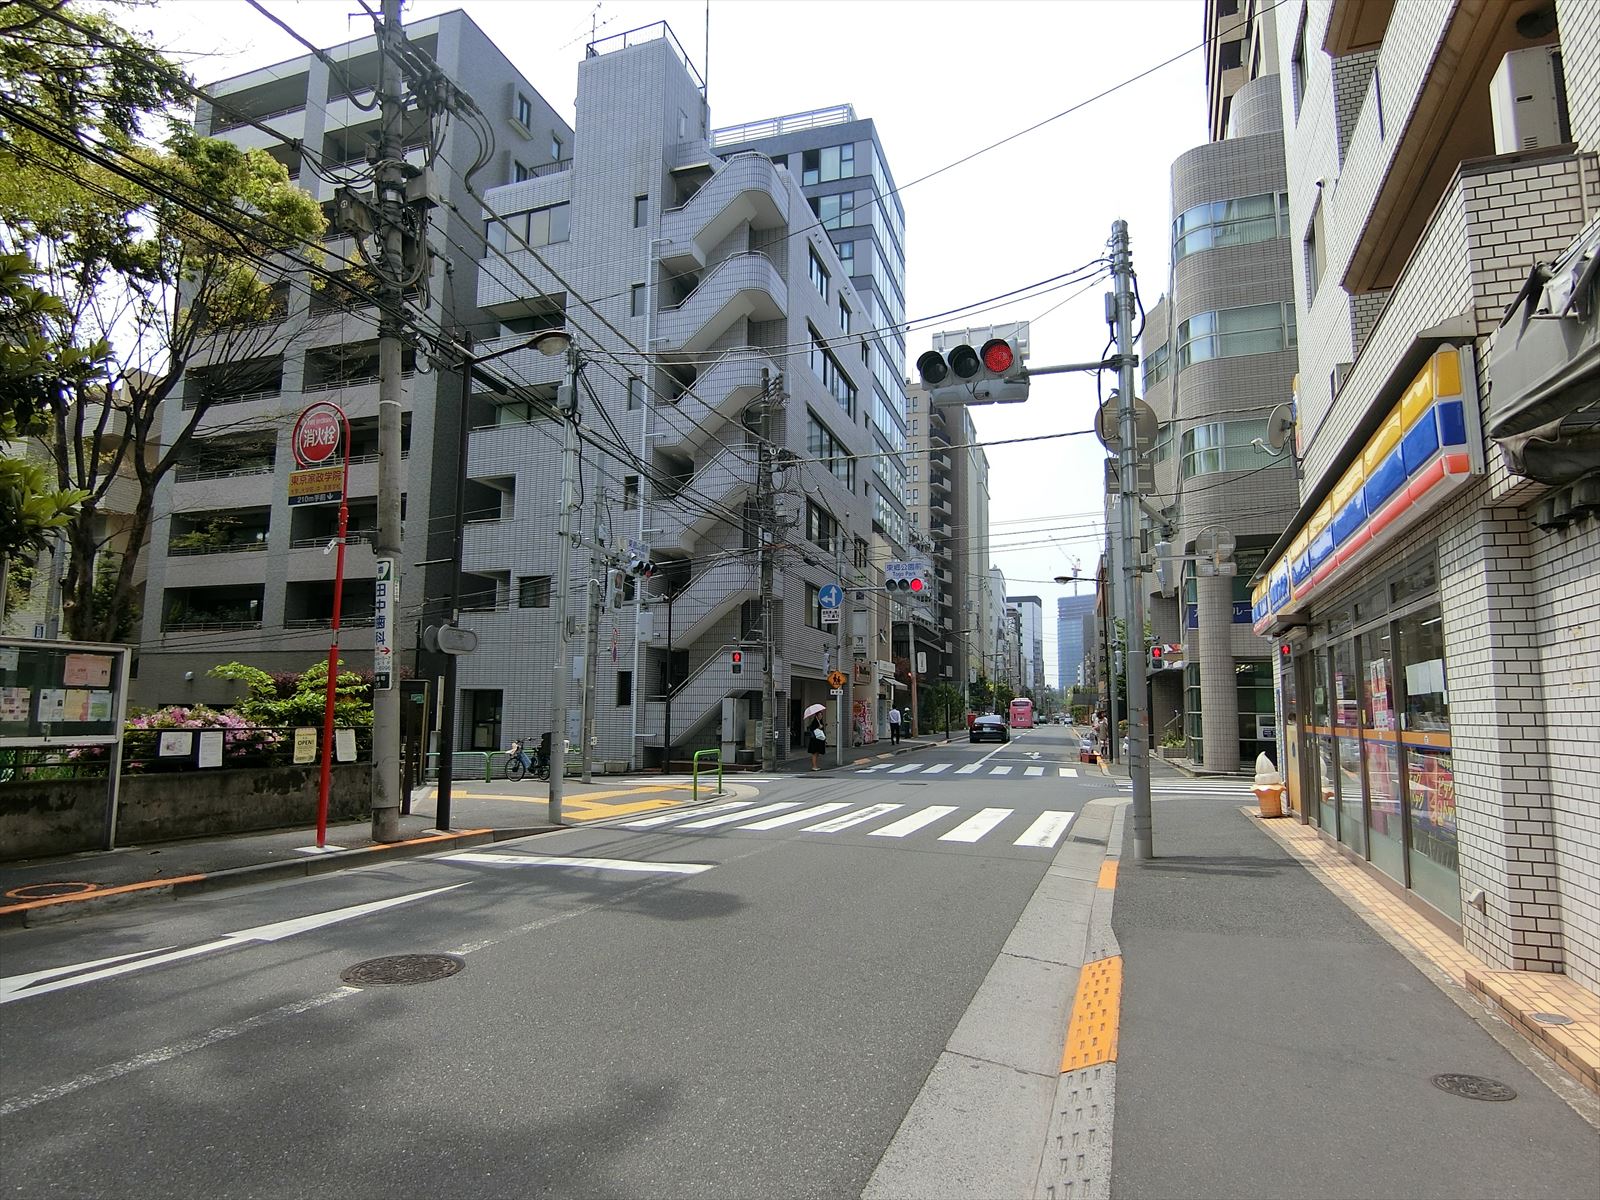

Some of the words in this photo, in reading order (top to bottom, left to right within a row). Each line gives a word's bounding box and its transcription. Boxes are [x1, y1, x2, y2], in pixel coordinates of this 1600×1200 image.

[303, 425, 336, 448] 消火栓
[291, 470, 342, 486] 東京家政学院
[886, 563, 922, 572] 東郷公園前
[375, 583, 387, 646] 田中歯科
